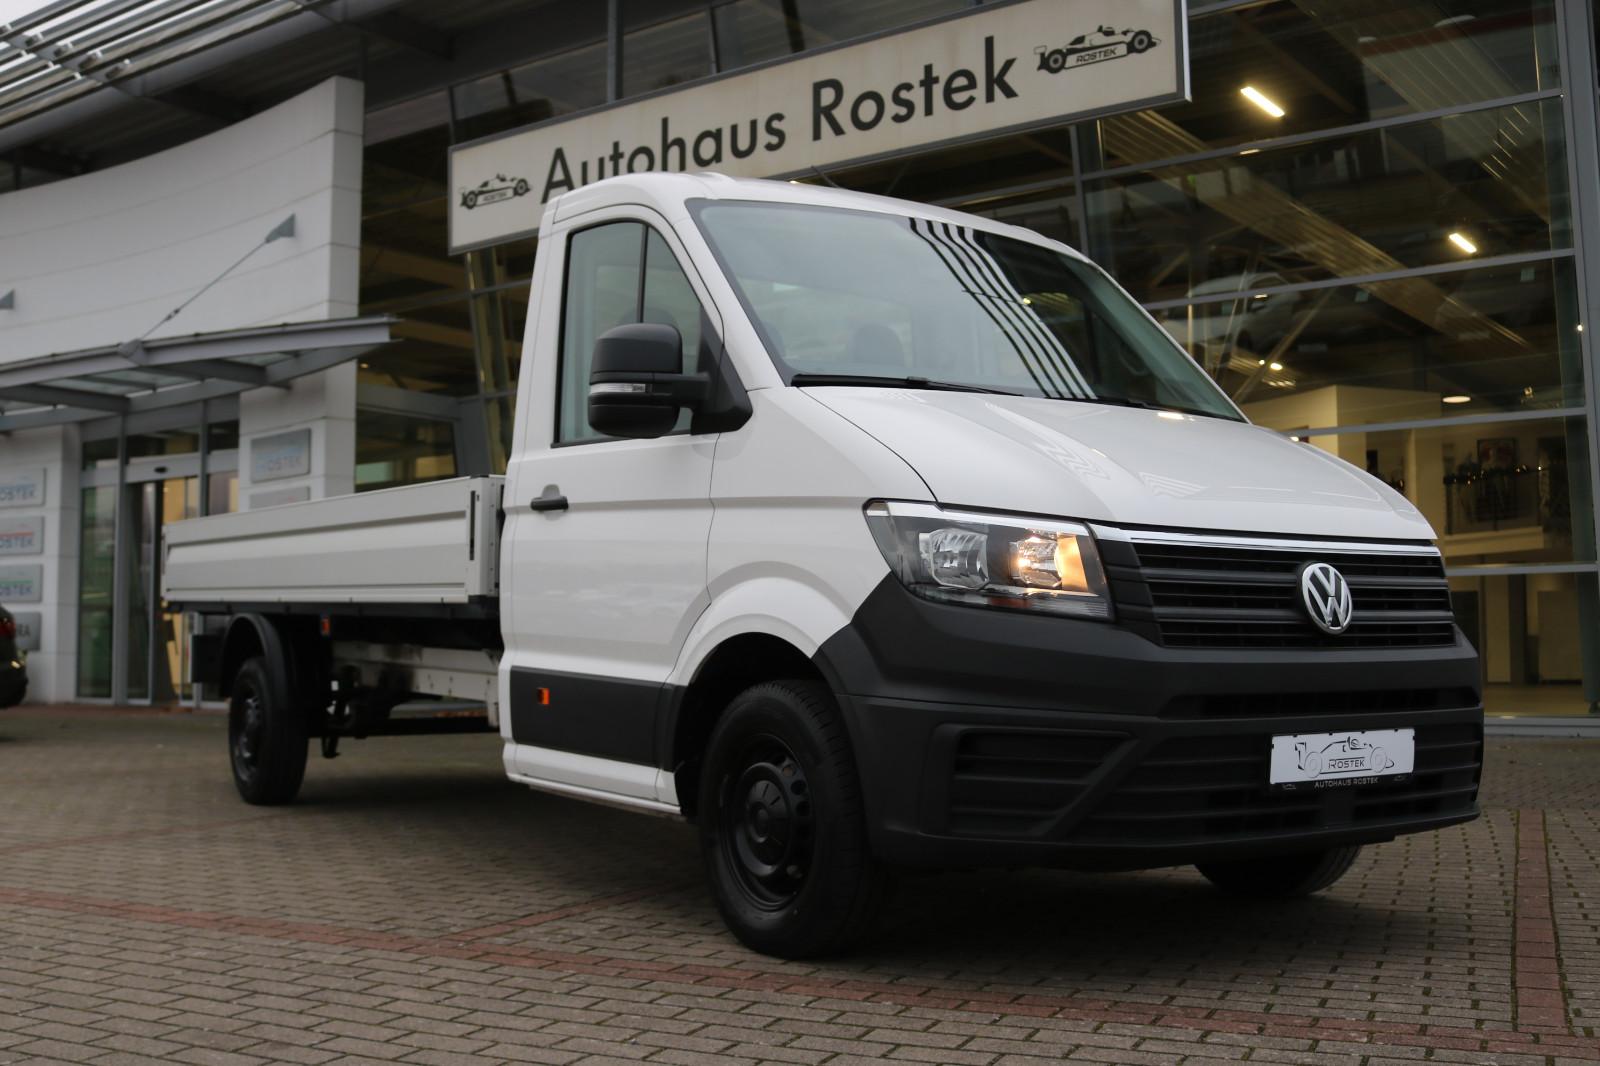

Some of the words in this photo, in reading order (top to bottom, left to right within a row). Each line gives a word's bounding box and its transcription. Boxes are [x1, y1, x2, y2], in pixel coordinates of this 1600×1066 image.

[1076, 47, 1117, 64] ROSTEK
[541, 116, 786, 204] Autohaus
[812, 35, 1019, 141] Rostek
[0, 485, 36, 501] OSTEK
[0, 537, 34, 549] OSTEK
[0, 585, 32, 597] OSTEK
[1329, 759, 1365, 769] ROSTEK
[1315, 780, 1351, 788] AUTOHAUS
[1354, 777, 1378, 785] ROSTEK
